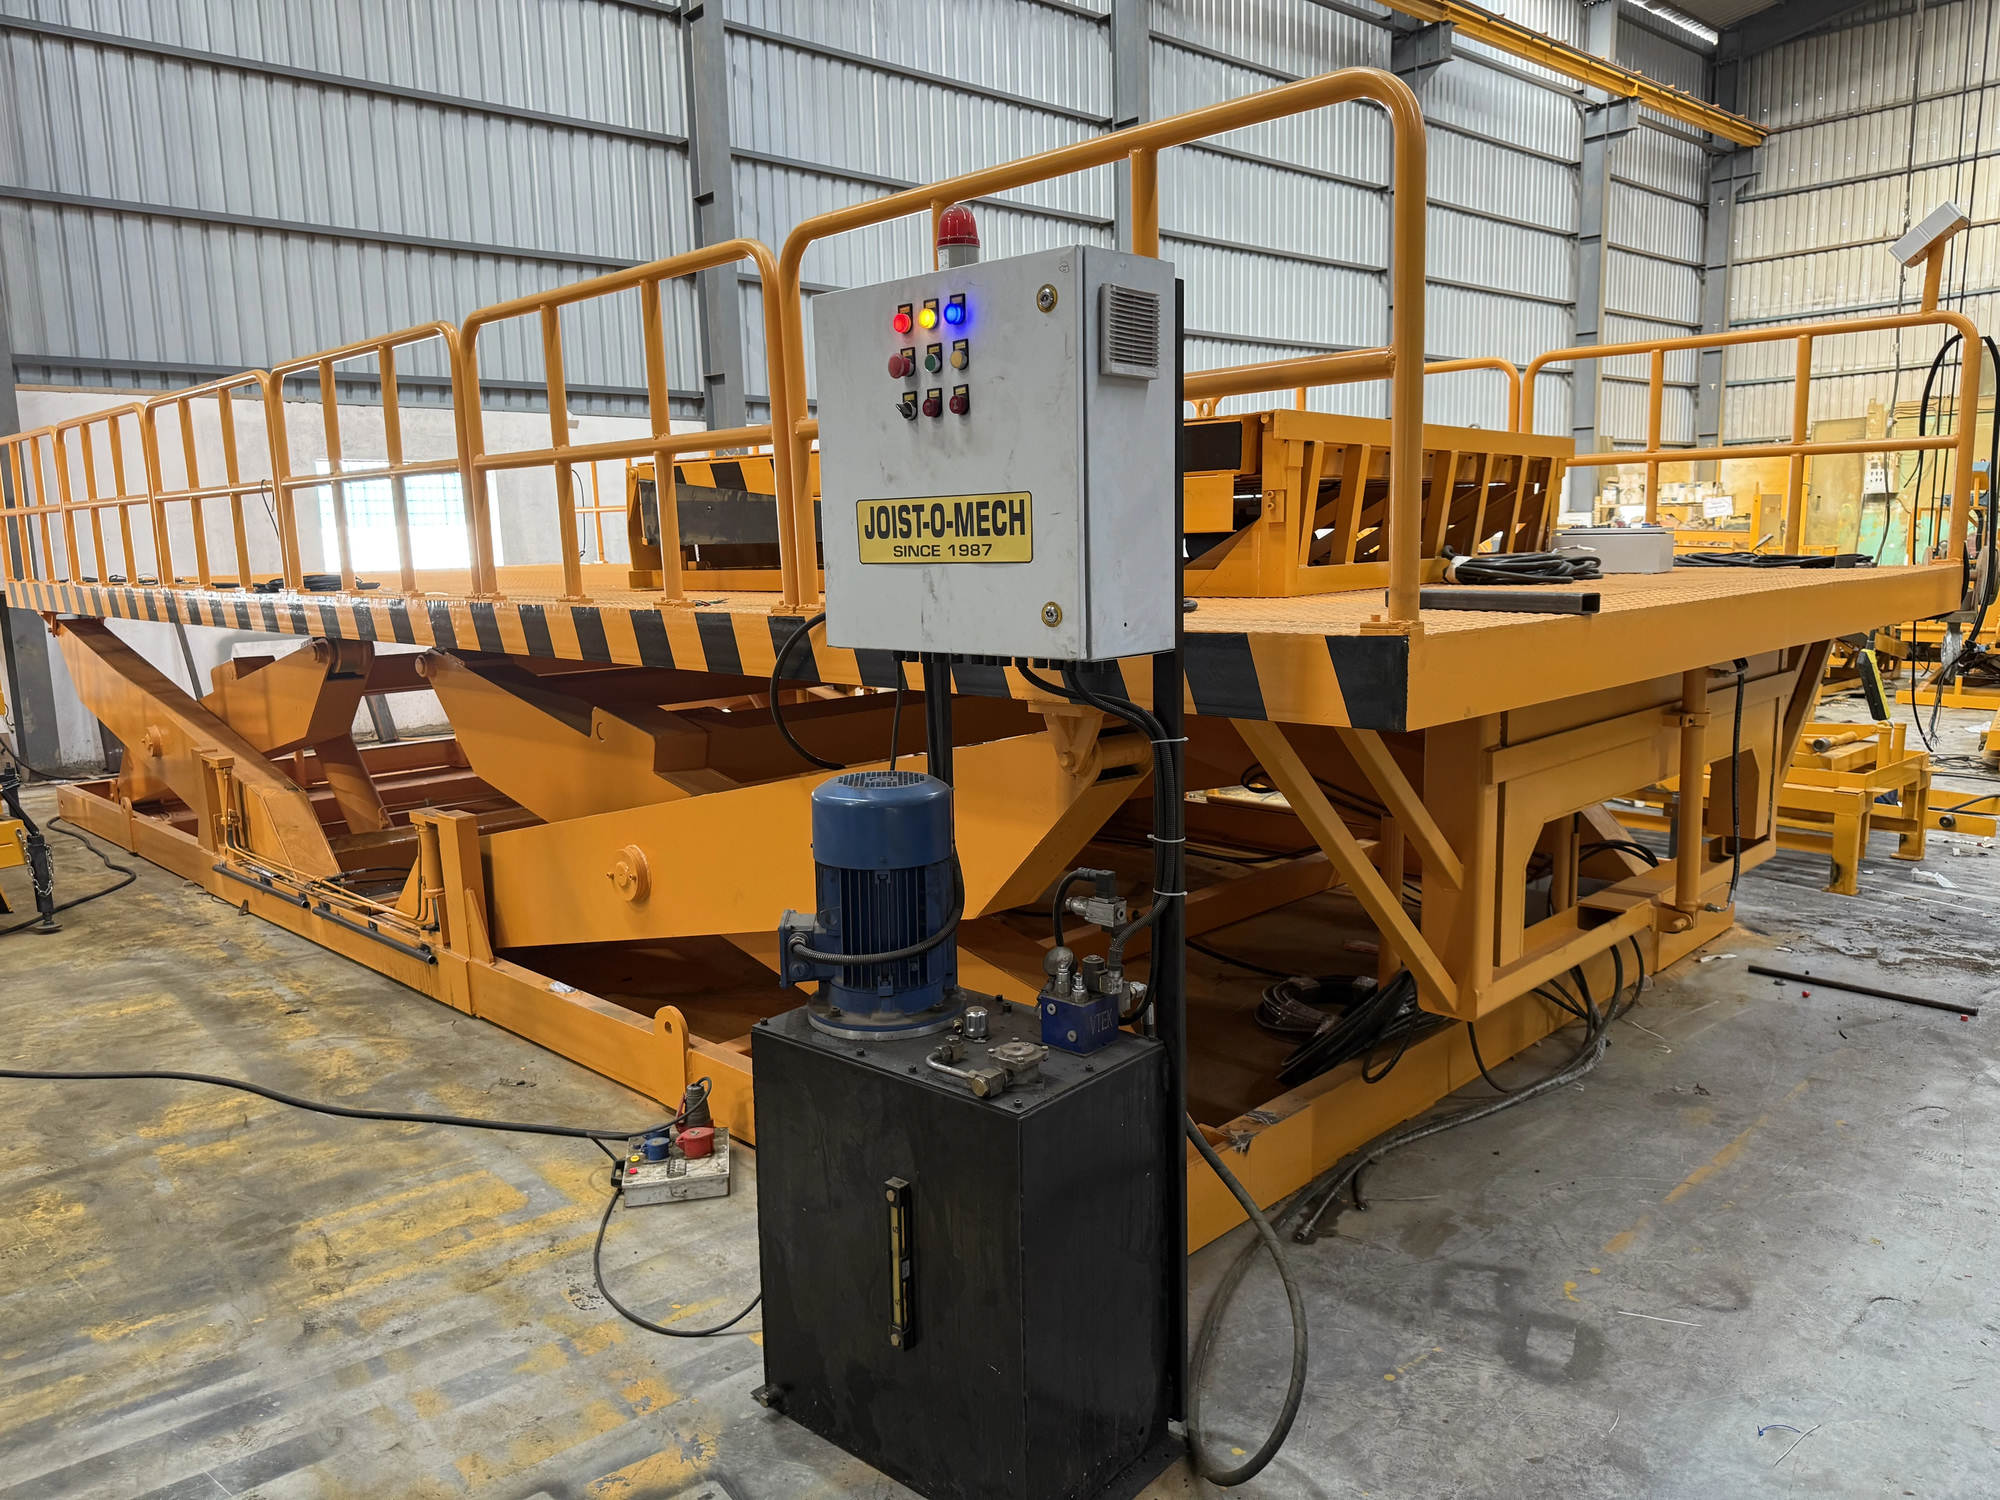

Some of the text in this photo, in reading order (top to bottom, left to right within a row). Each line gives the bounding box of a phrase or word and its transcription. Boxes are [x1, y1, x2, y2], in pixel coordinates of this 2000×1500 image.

[864, 499, 1025, 539] JOIST-O-MECH
[893, 543, 992, 557] SINCE 1987
